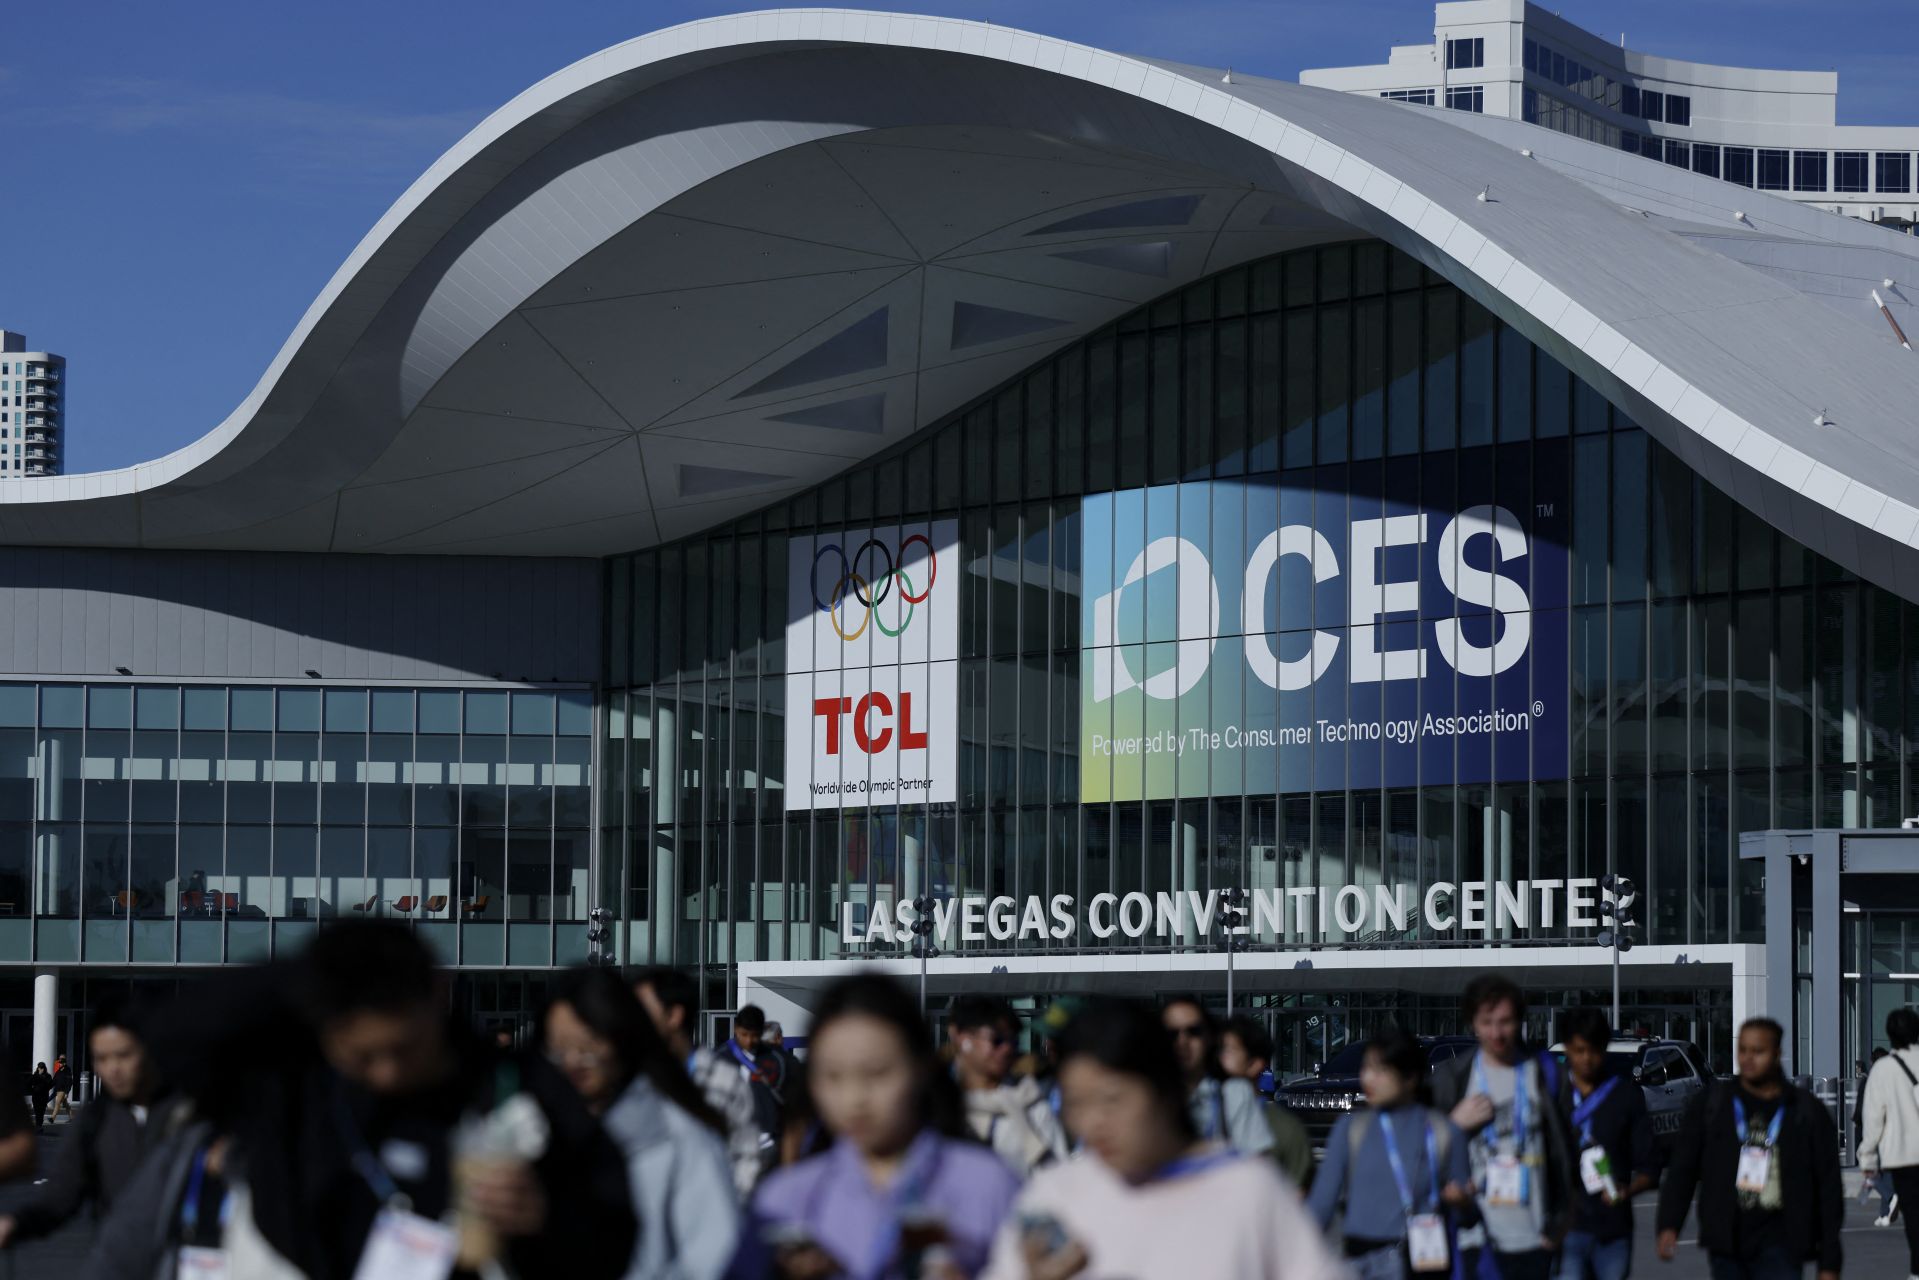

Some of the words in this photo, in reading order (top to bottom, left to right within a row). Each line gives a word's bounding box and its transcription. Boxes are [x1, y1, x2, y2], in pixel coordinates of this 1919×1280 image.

[1241, 504, 1531, 691] CES
[814, 691, 928, 755] TCL
[1092, 730, 1162, 757] Powered
[1167, 730, 1186, 757] by
[1188, 727, 1220, 751] The
[1225, 725, 1312, 750] Consumer
[1317, 718, 1418, 744] Technoogy
[898, 777, 933, 791] Partner
[843, 898, 916, 943] LAS
[932, 894, 1076, 942] VEGAS
[1088, 883, 1408, 938] CONVENTION
